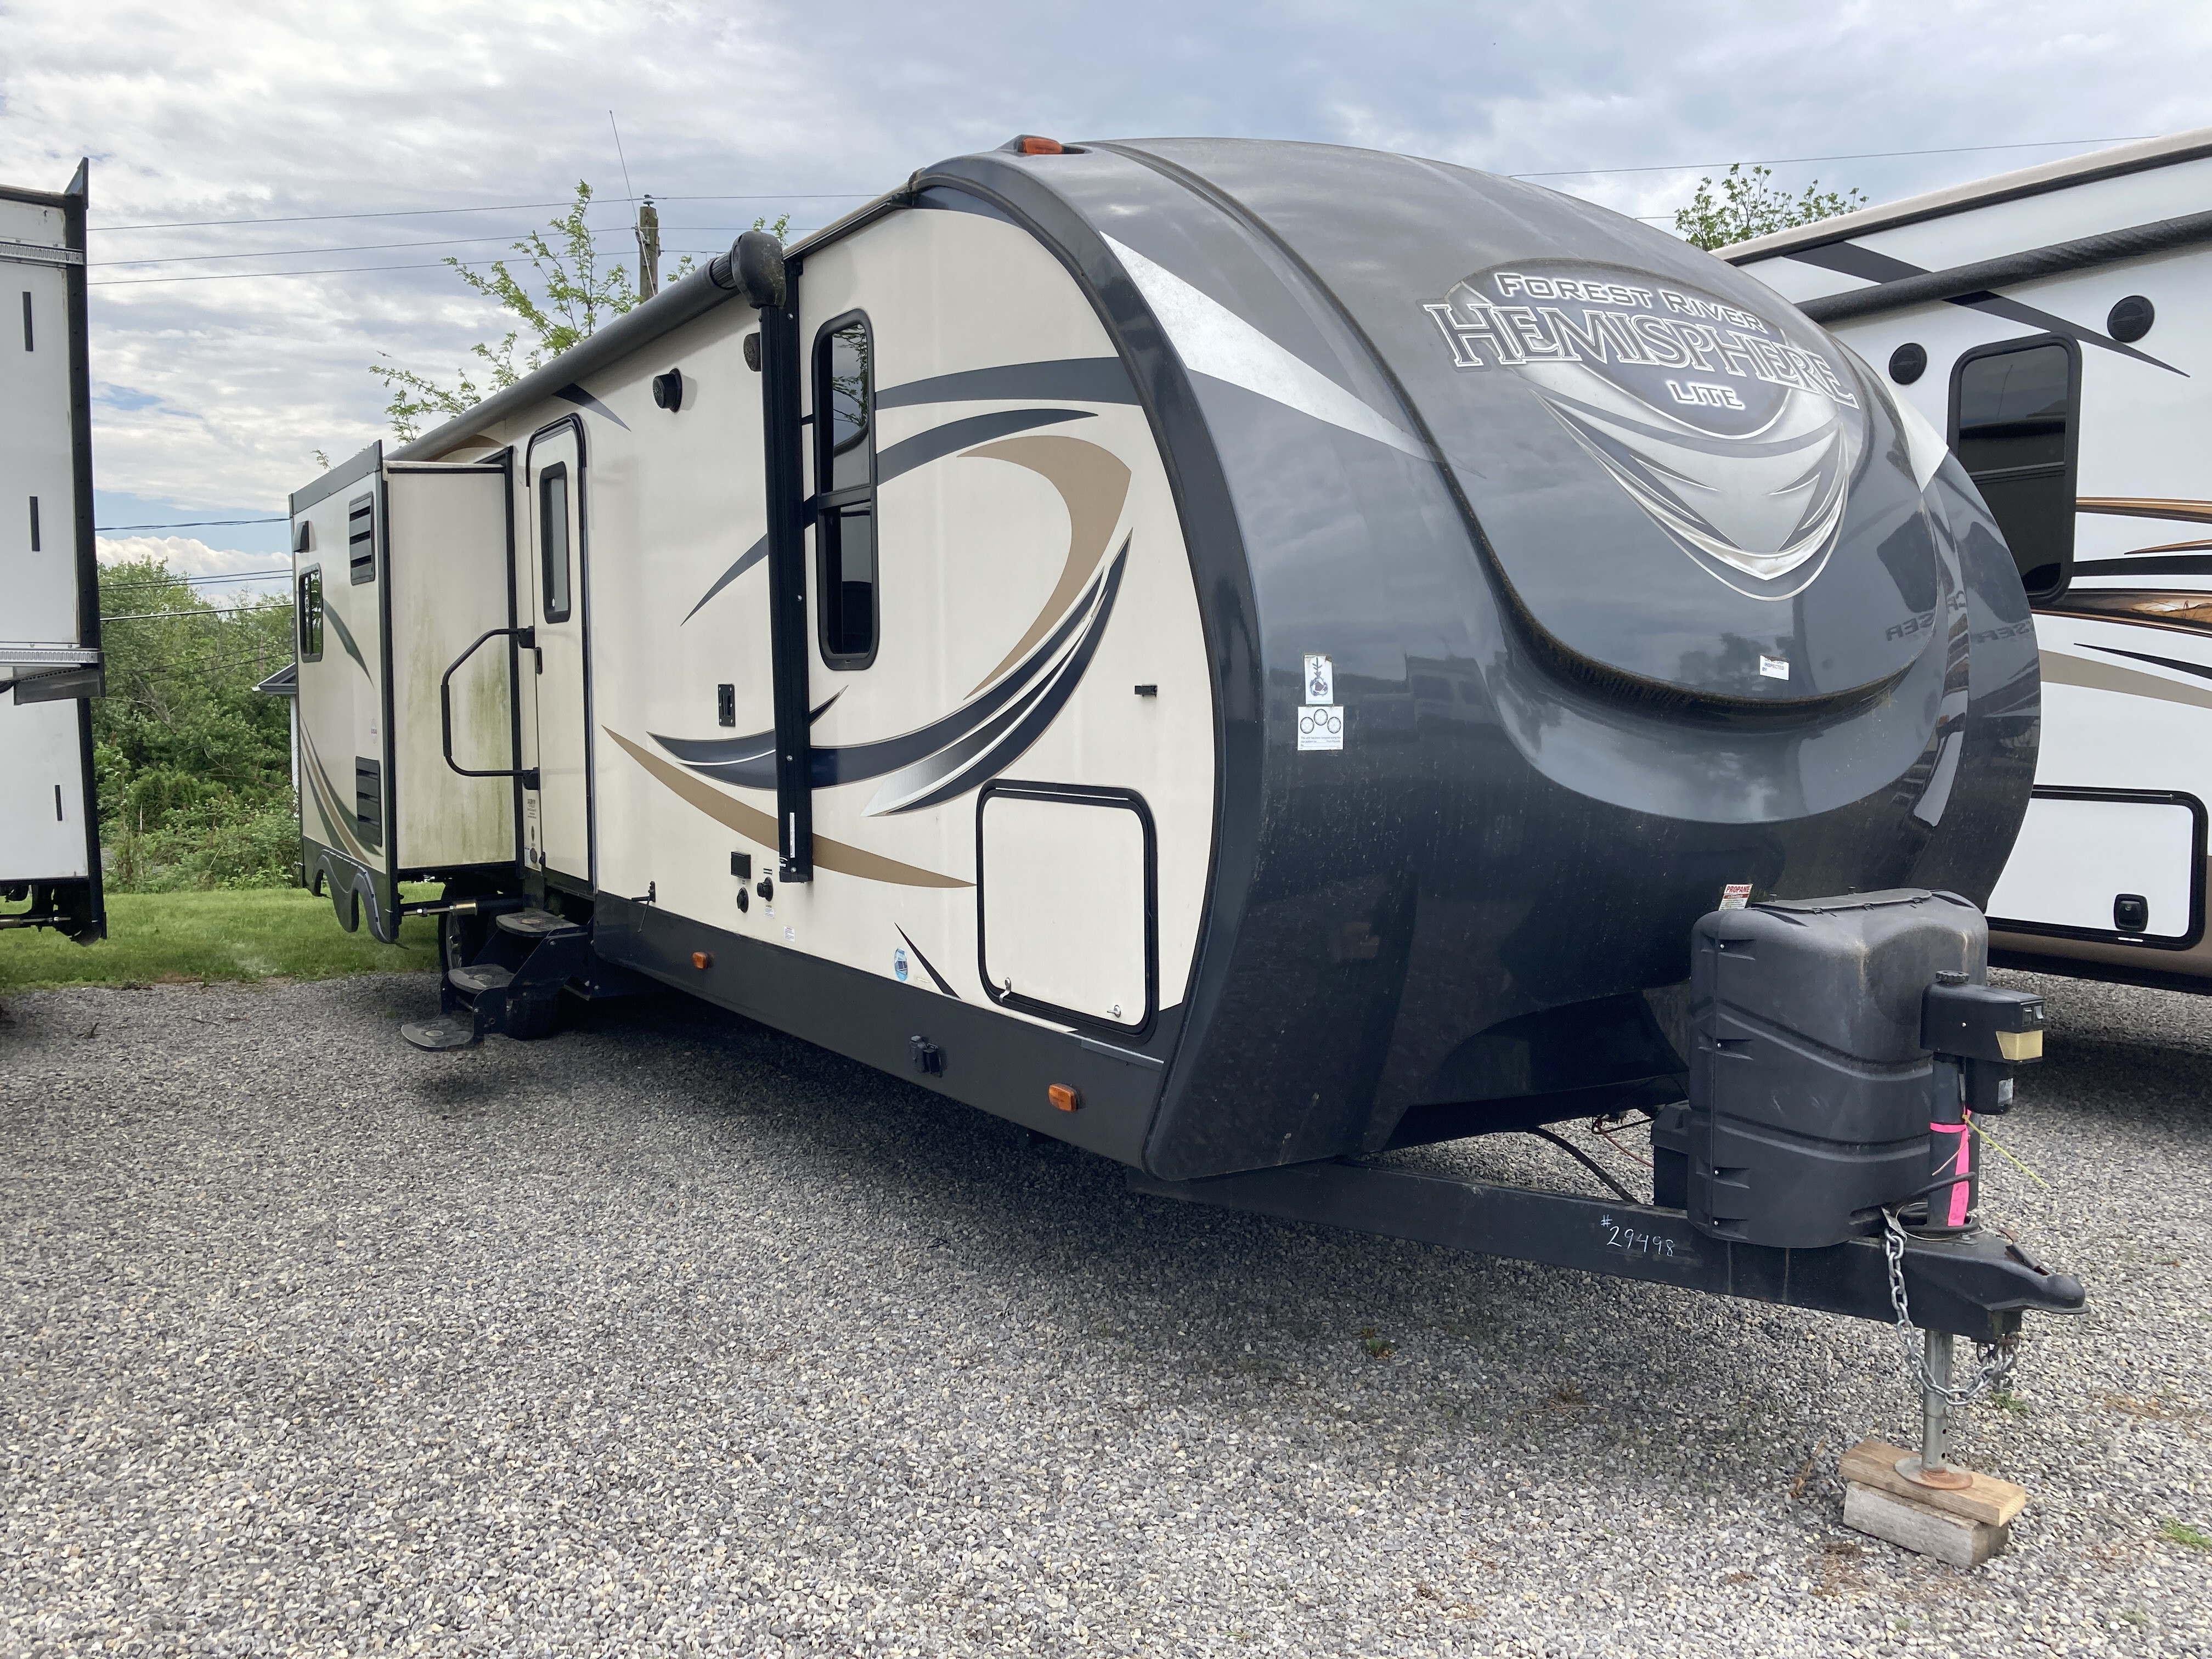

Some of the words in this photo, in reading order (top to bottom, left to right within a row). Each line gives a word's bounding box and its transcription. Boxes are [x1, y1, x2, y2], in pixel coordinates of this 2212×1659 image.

[1495, 273, 1652, 309] FOREST
[1661, 290, 1768, 333] RIVER
[1423, 303, 1859, 410] HEMISPHERE
[1668, 382, 1744, 409] LITE
[1600, 1214, 1675, 1257] #29498
